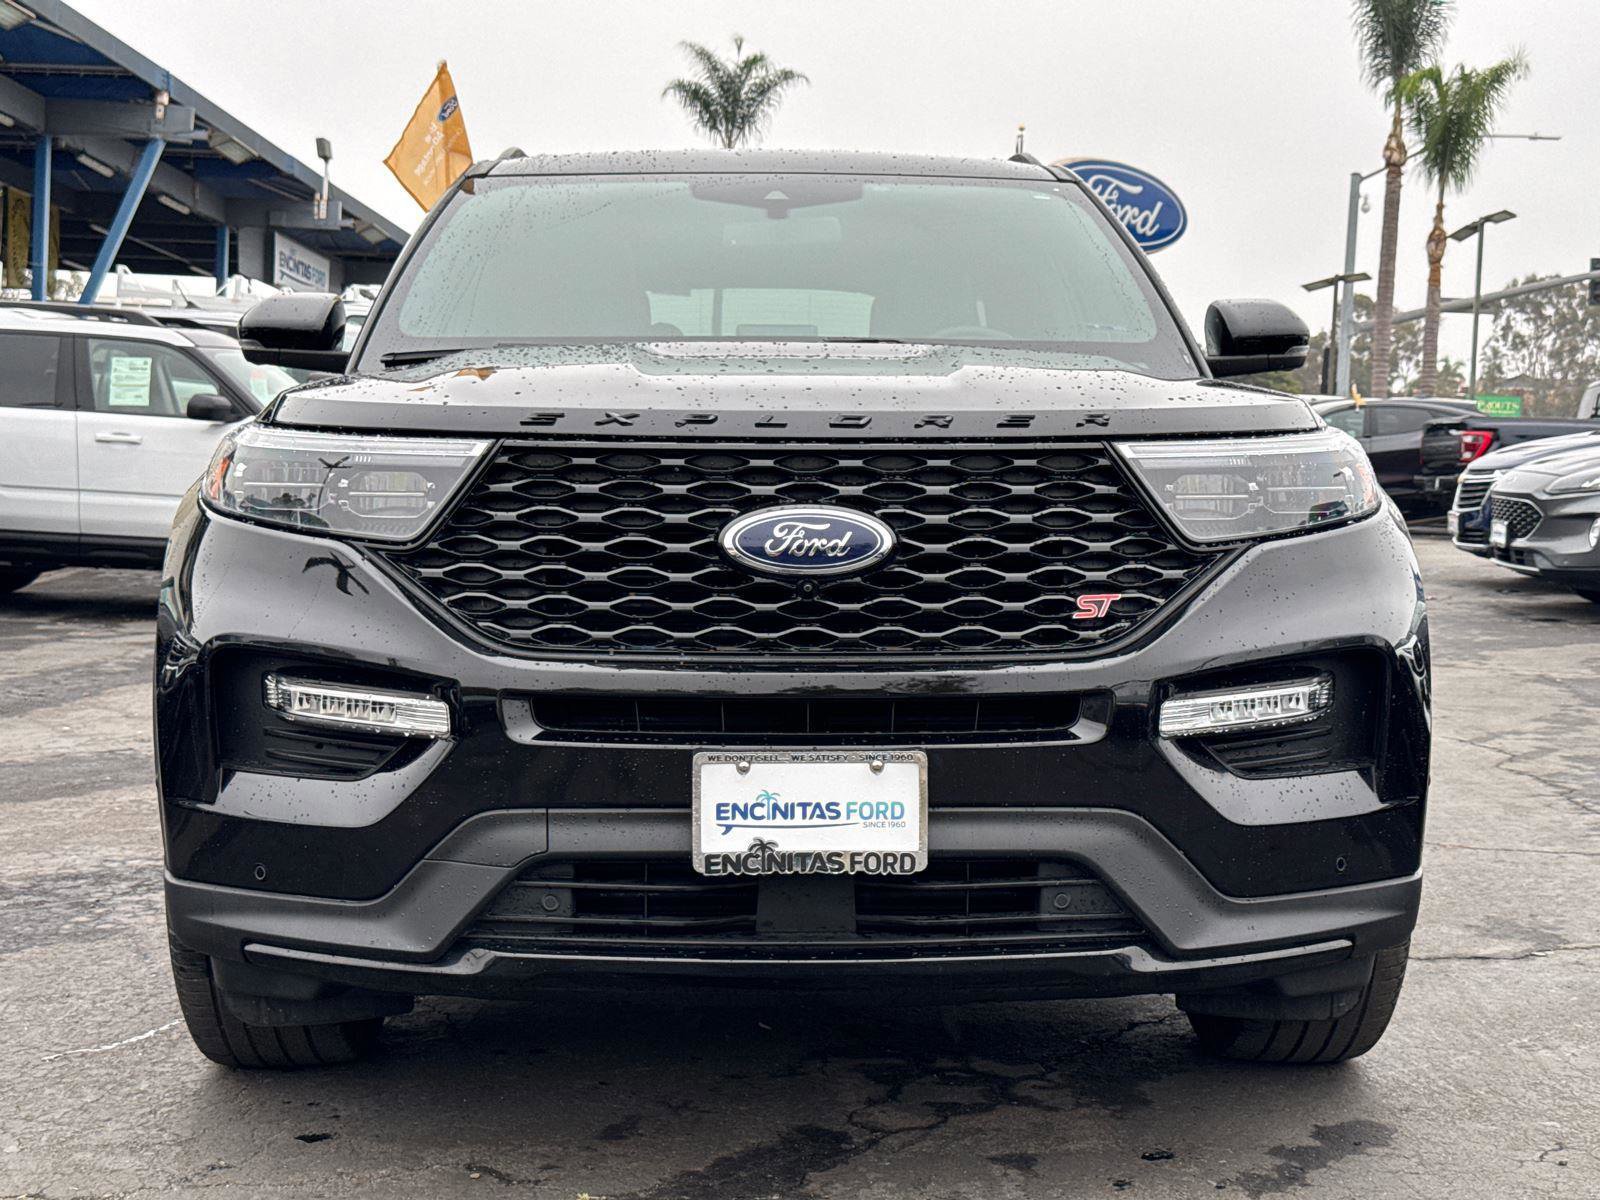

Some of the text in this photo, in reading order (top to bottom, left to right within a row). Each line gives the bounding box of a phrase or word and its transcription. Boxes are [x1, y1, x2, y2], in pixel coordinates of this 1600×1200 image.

[519, 411, 1111, 429] EXPLORER
[764, 521, 853, 557] Ford
[1072, 594, 1121, 619] ST
[707, 754, 722, 762] WE
[755, 754, 780, 762] SELL
[791, 754, 806, 762] WE
[808, 754, 849, 762] SATISFY
[859, 754, 888, 762] SINCE
[891, 753, 914, 761] 1960
[715, 800, 905, 821] ENCINITAS FORD
[704, 851, 917, 874] ENCINITAS FORD
